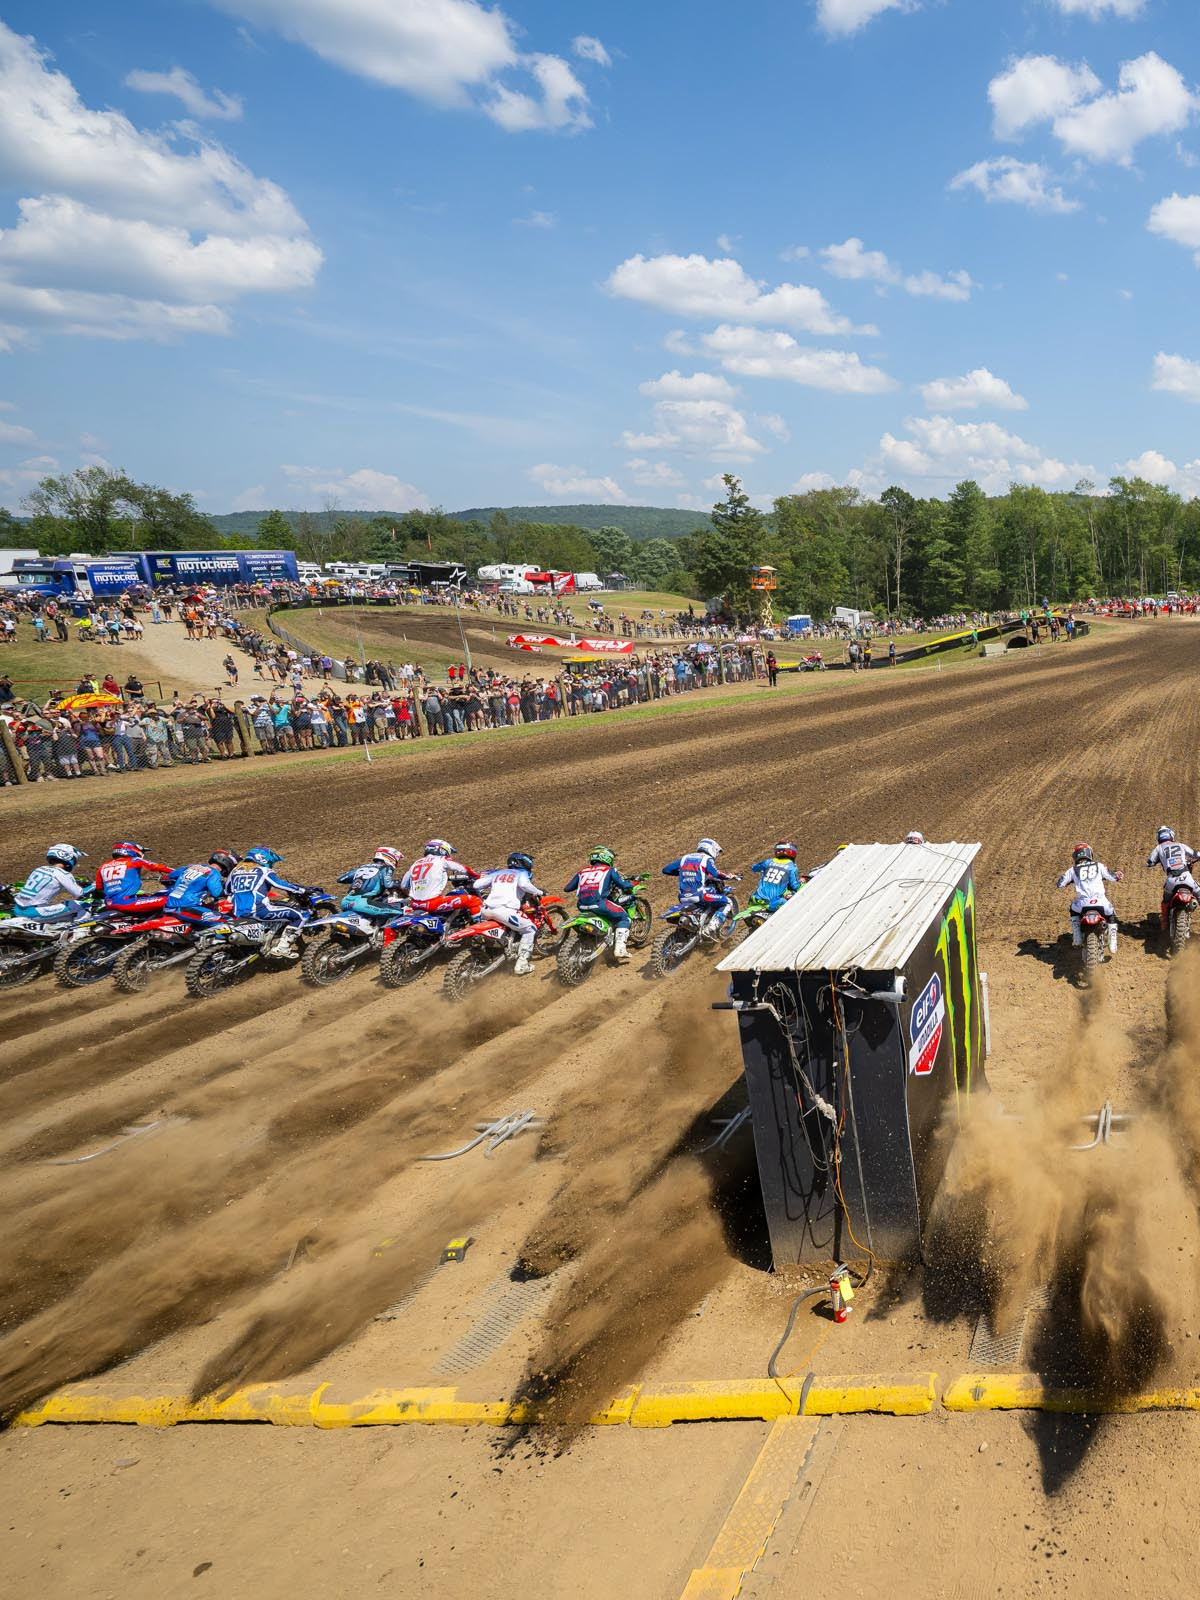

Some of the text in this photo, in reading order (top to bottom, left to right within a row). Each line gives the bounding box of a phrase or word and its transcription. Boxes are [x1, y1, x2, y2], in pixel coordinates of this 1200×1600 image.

[177, 560, 239, 571] MOTOCROSS
[1163, 845, 1182, 859] 12
[410, 863, 433, 882] 97
[493, 874, 516, 884] 148
[763, 868, 786, 885] 535
[1079, 865, 1098, 882] 68
[232, 875, 257, 892] 483
[265, 910, 291, 919] FXR
[427, 919, 438, 928] 97
[591, 918, 603, 928] 79
[916, 993, 930, 1028] elf
